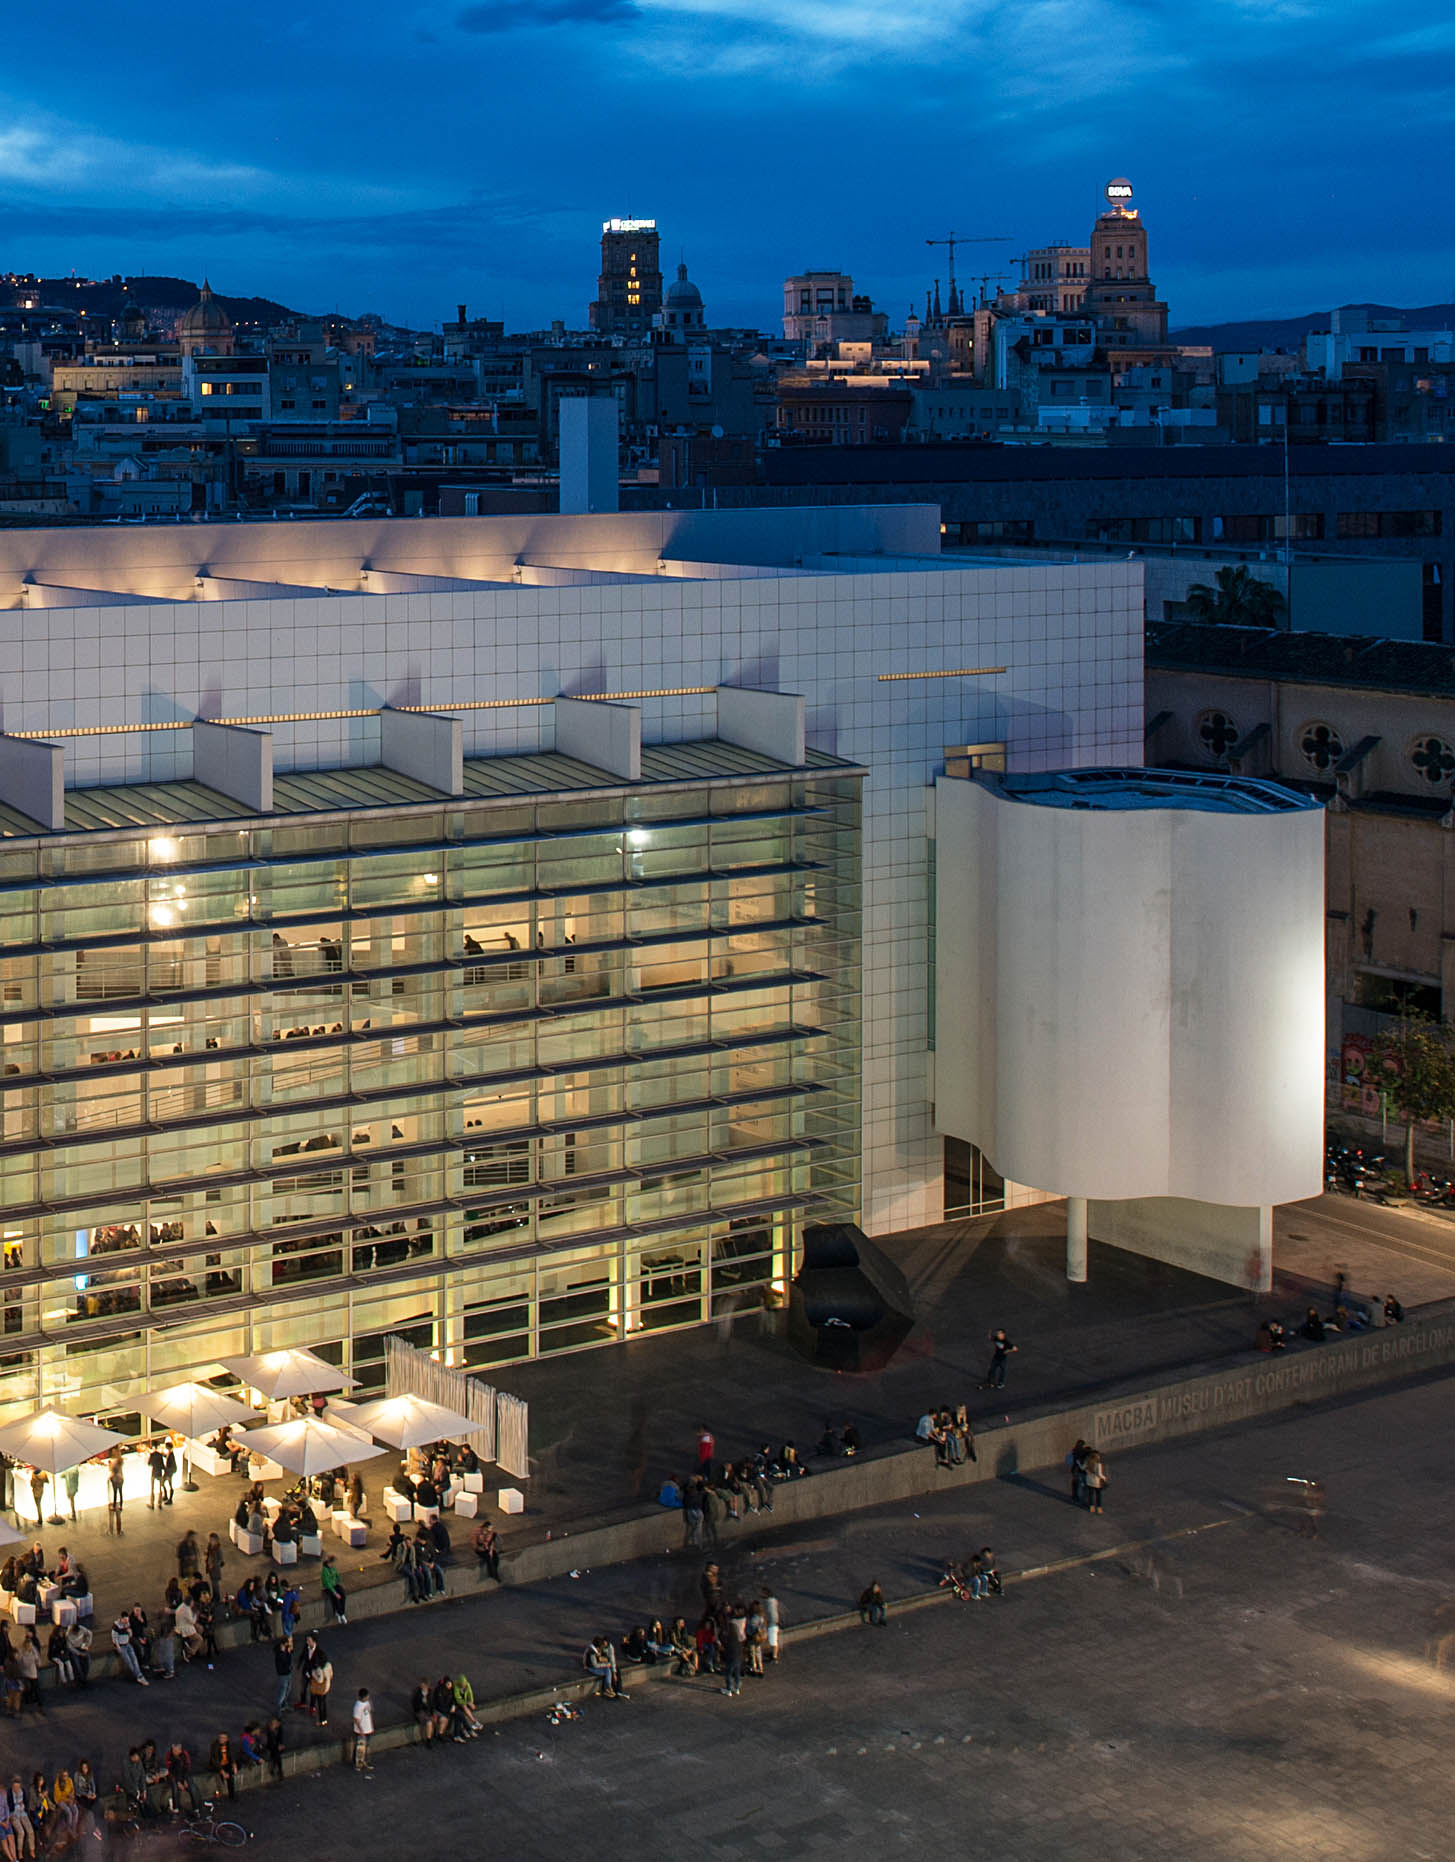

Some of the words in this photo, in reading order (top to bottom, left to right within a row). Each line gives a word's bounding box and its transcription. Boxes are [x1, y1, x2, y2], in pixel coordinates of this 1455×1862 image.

[1098, 1404, 1153, 1437] MACBA
[1161, 1388, 1209, 1420] MUSEU
[1214, 1378, 1252, 1405] D'ART
[1362, 1344, 1379, 1366] DE
[1381, 1327, 1454, 1361] BARCELONA
